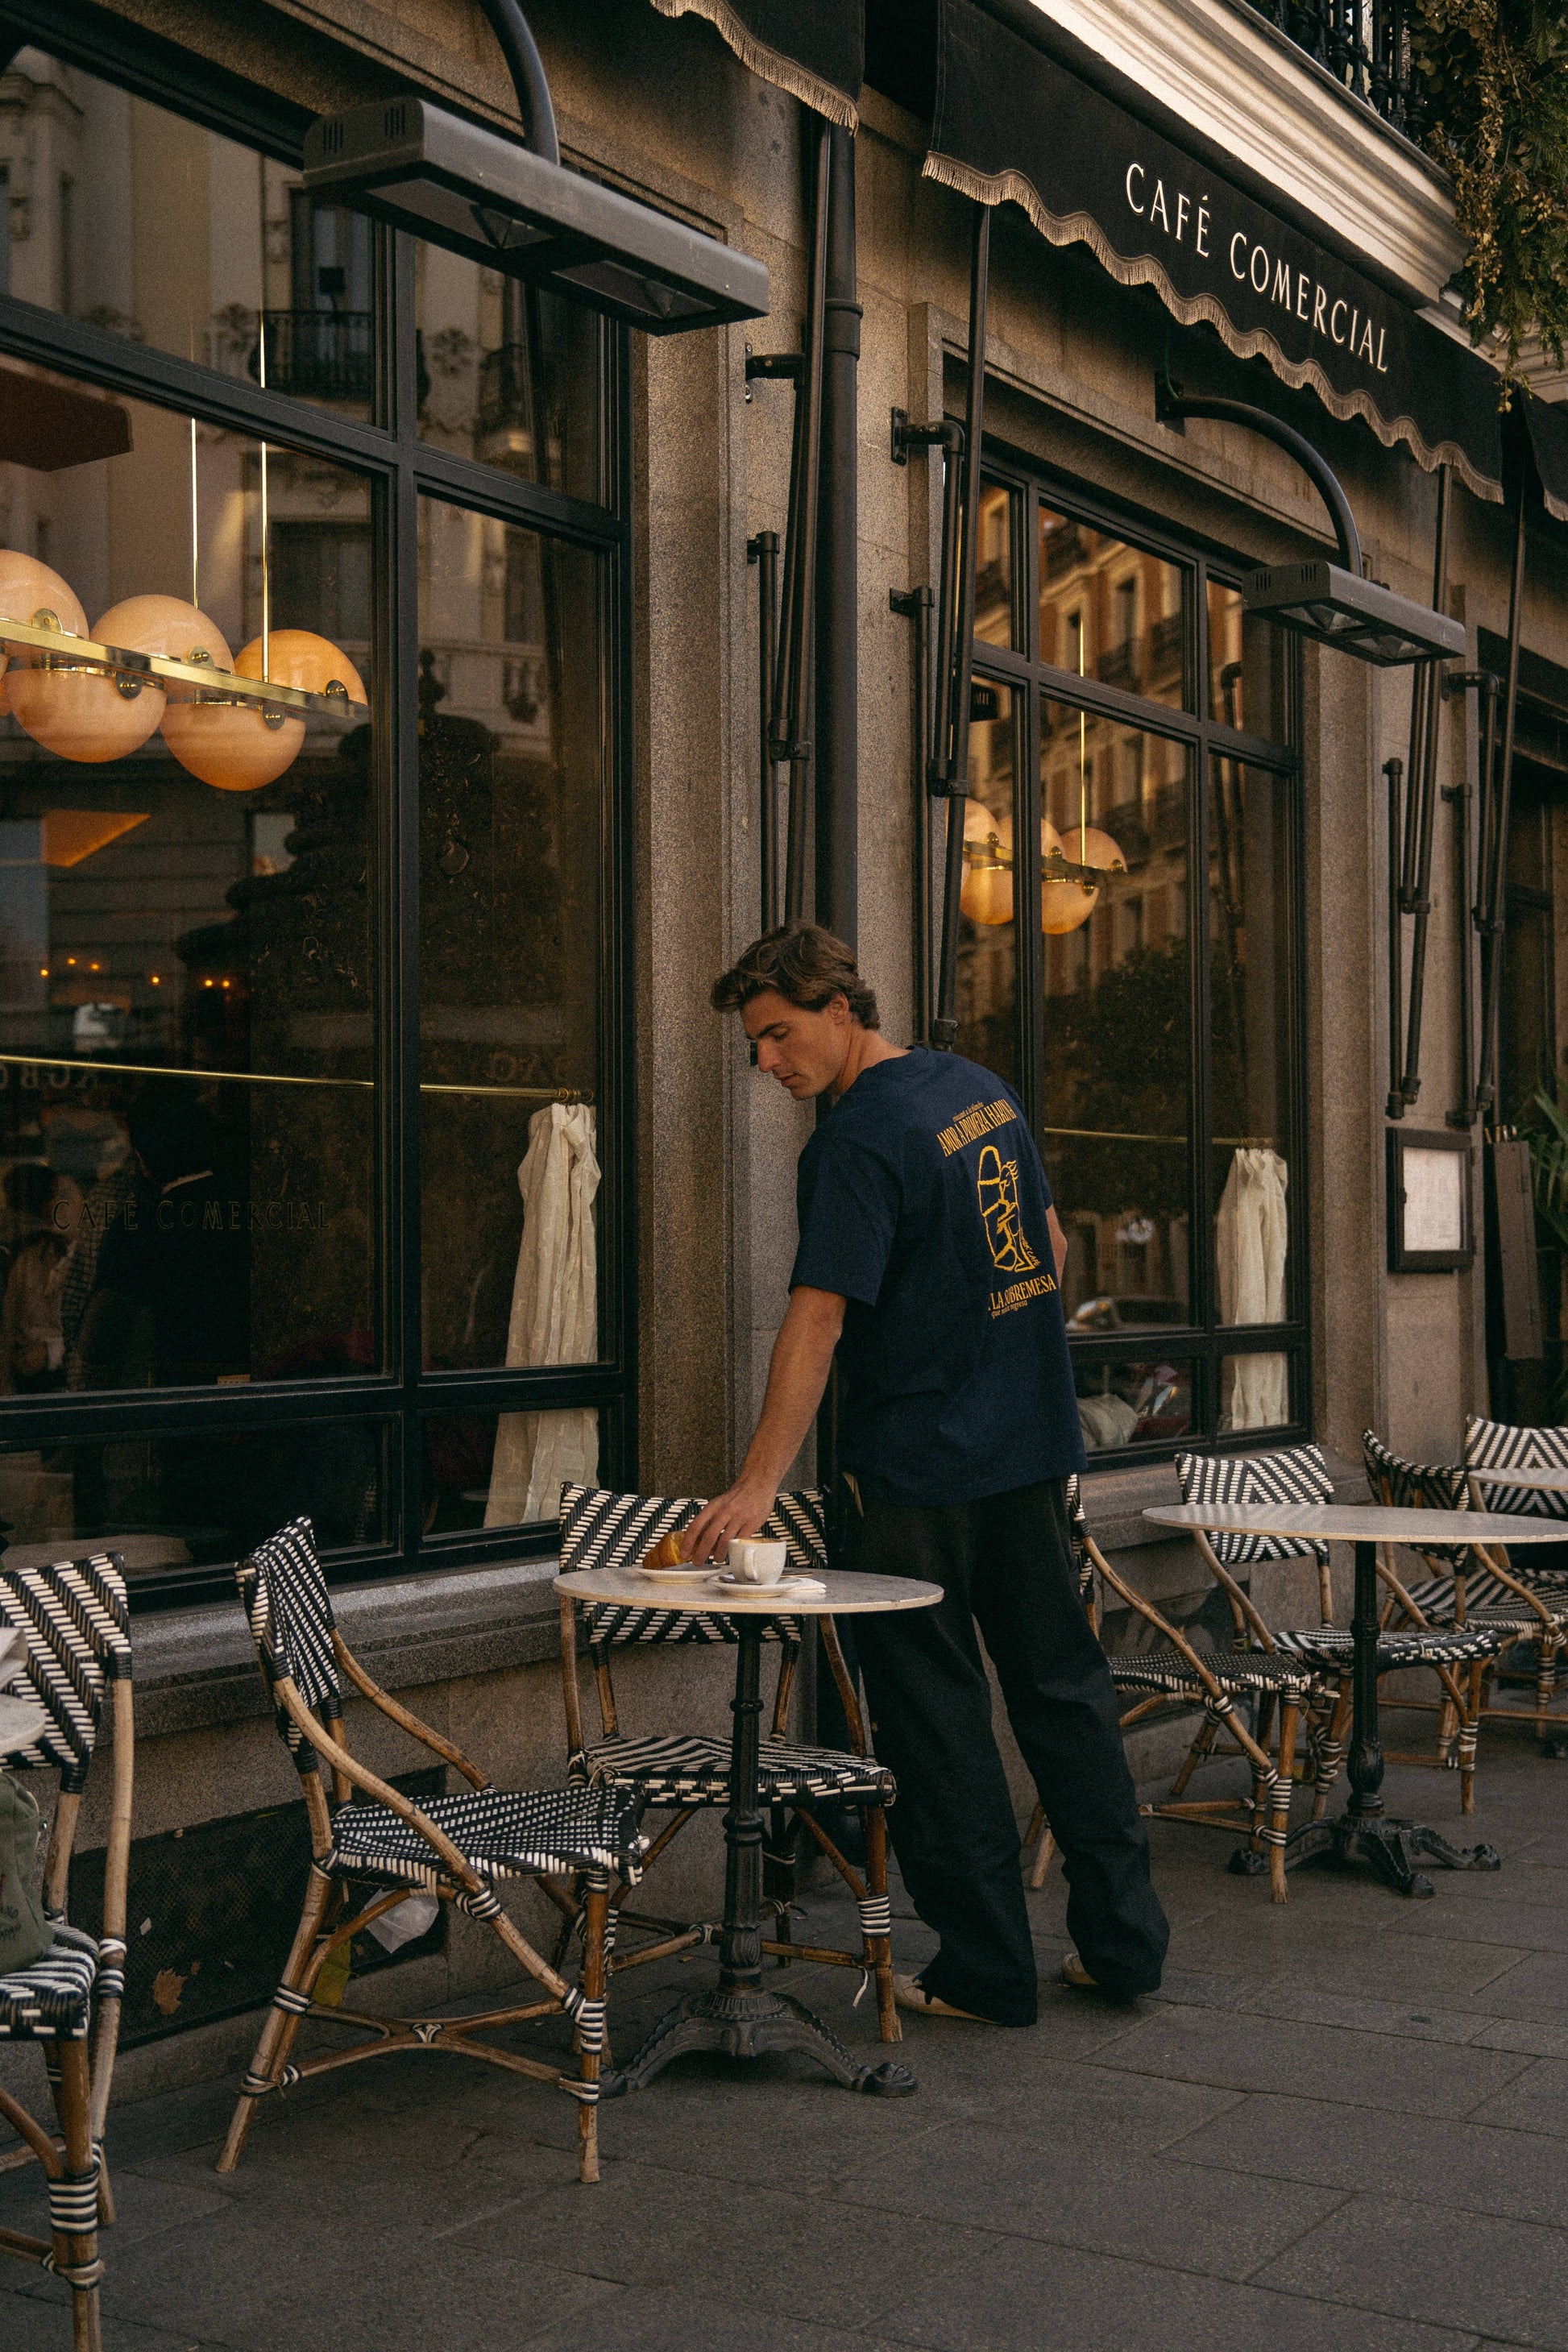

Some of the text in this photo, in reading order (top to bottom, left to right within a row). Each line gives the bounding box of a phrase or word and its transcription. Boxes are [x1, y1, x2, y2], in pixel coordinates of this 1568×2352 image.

[1126, 163, 1388, 374] CAFÉ COMERCIAL
[936, 1126, 964, 1157] AMOR
[954, 1123, 969, 1146] A
[958, 1110, 994, 1143] PRIMERA
[52, 1193, 332, 1231] CAFÉ COMERCIAL
[1004, 1274, 1057, 1306] OBREMESA
